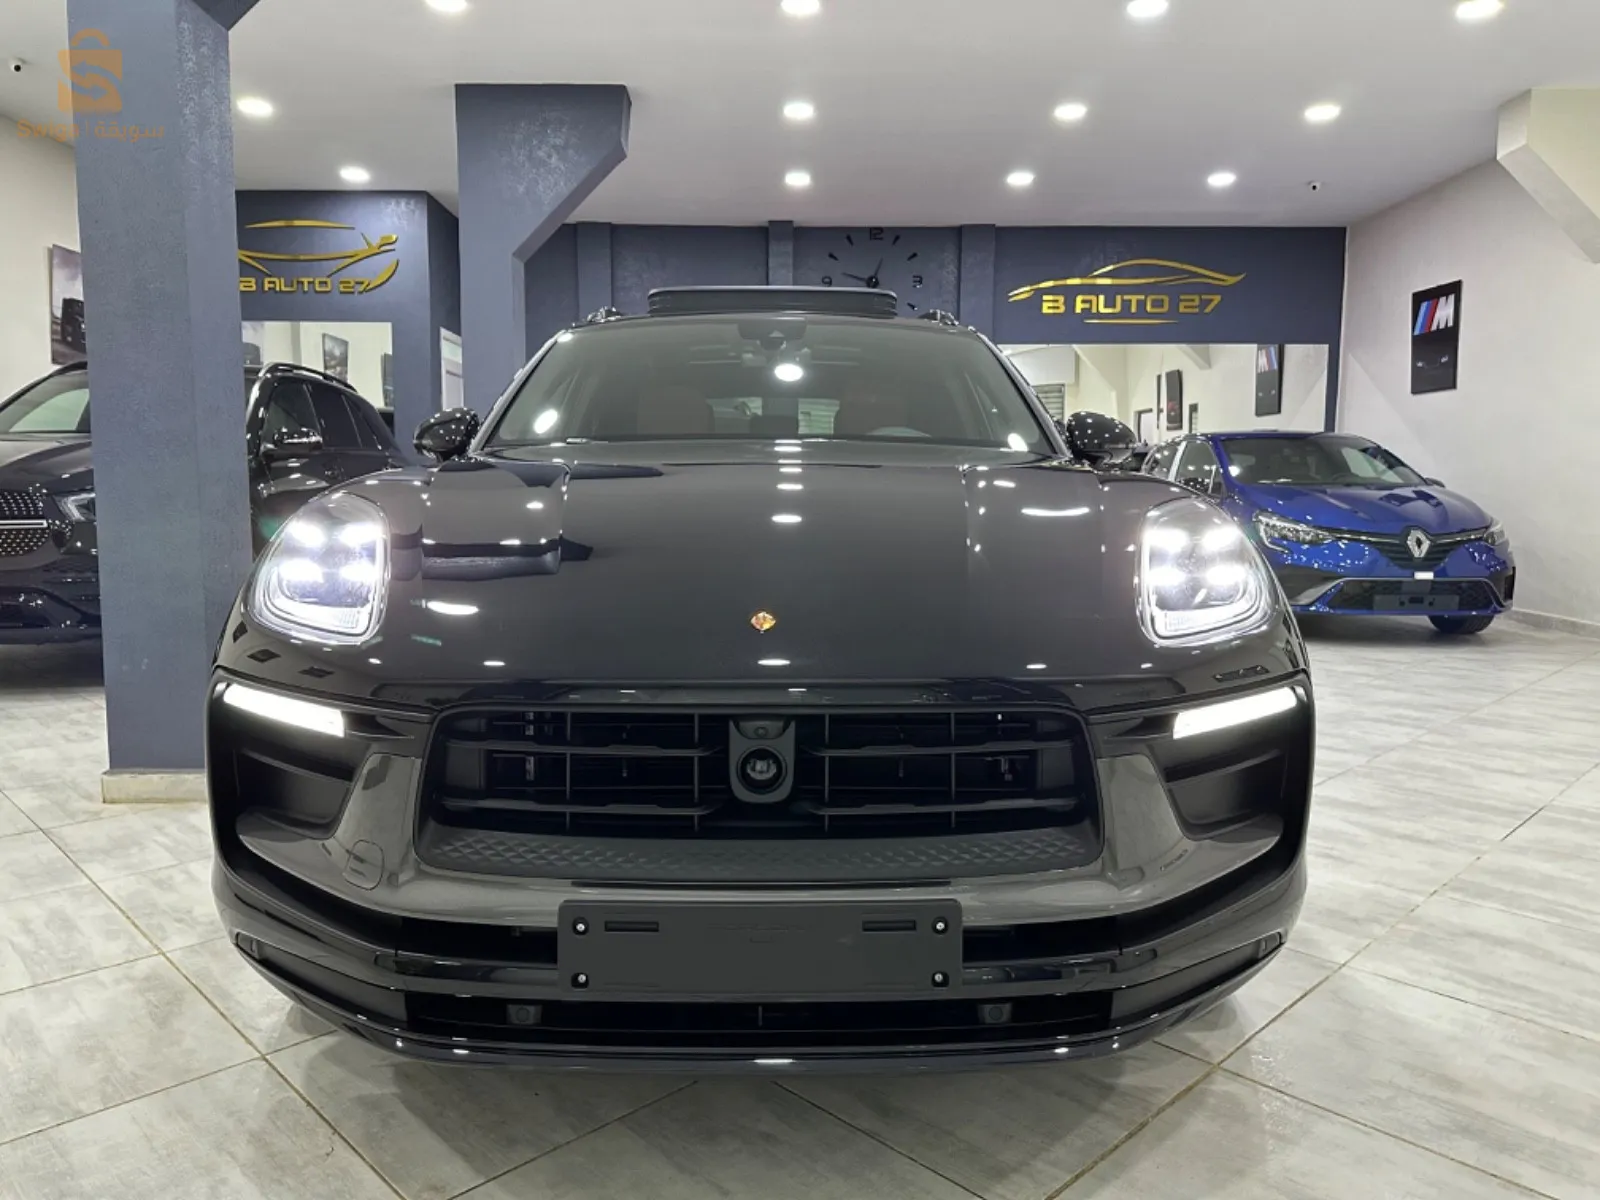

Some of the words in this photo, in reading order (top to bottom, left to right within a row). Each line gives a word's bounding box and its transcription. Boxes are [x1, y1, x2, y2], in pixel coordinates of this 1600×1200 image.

[264, 277, 333, 292] AUTO
[339, 279, 371, 293] 27
[1041, 294, 1066, 314] B
[1074, 294, 1170, 314] AUTO
[1178, 294, 1222, 314] 27
